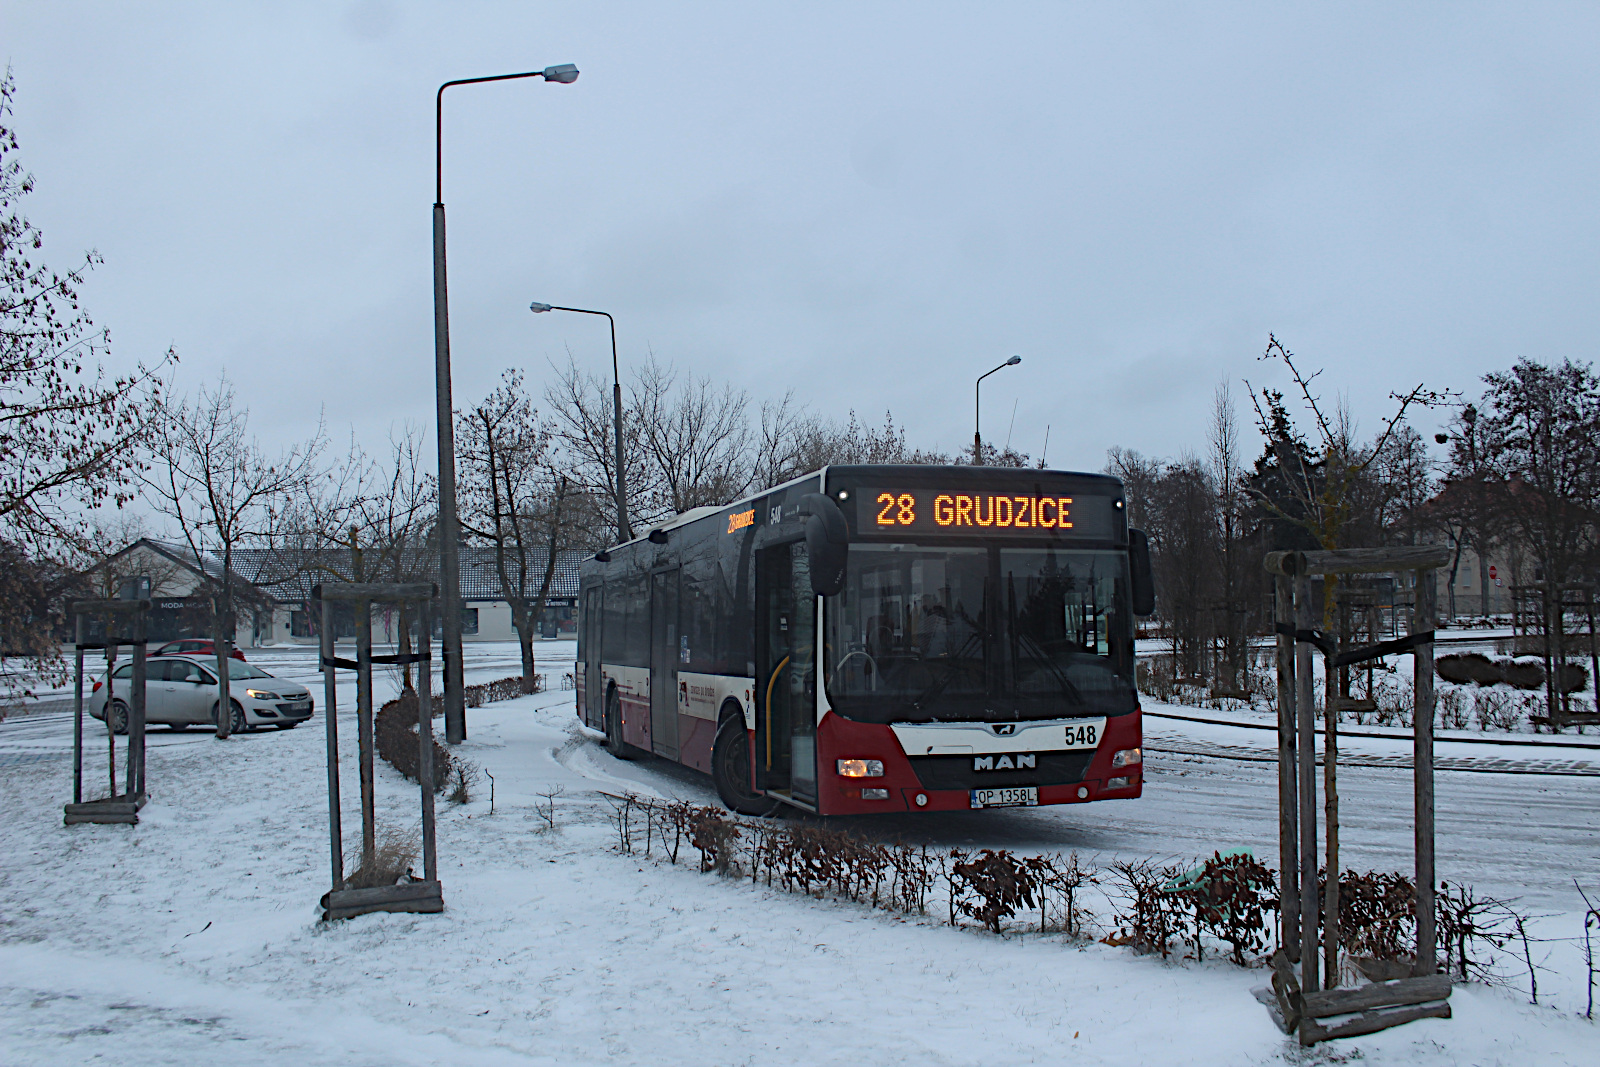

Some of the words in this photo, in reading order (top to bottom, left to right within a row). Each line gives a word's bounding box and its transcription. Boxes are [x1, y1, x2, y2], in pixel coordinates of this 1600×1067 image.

[770, 505, 782, 525] 548
[877, 493, 915, 525] 28
[934, 494, 1073, 528] GRUDZICE
[1065, 726, 1097, 746] 548
[975, 755, 1036, 770] MAN
[978, 790, 994, 804] OP
[999, 788, 1034, 803] 1358L
